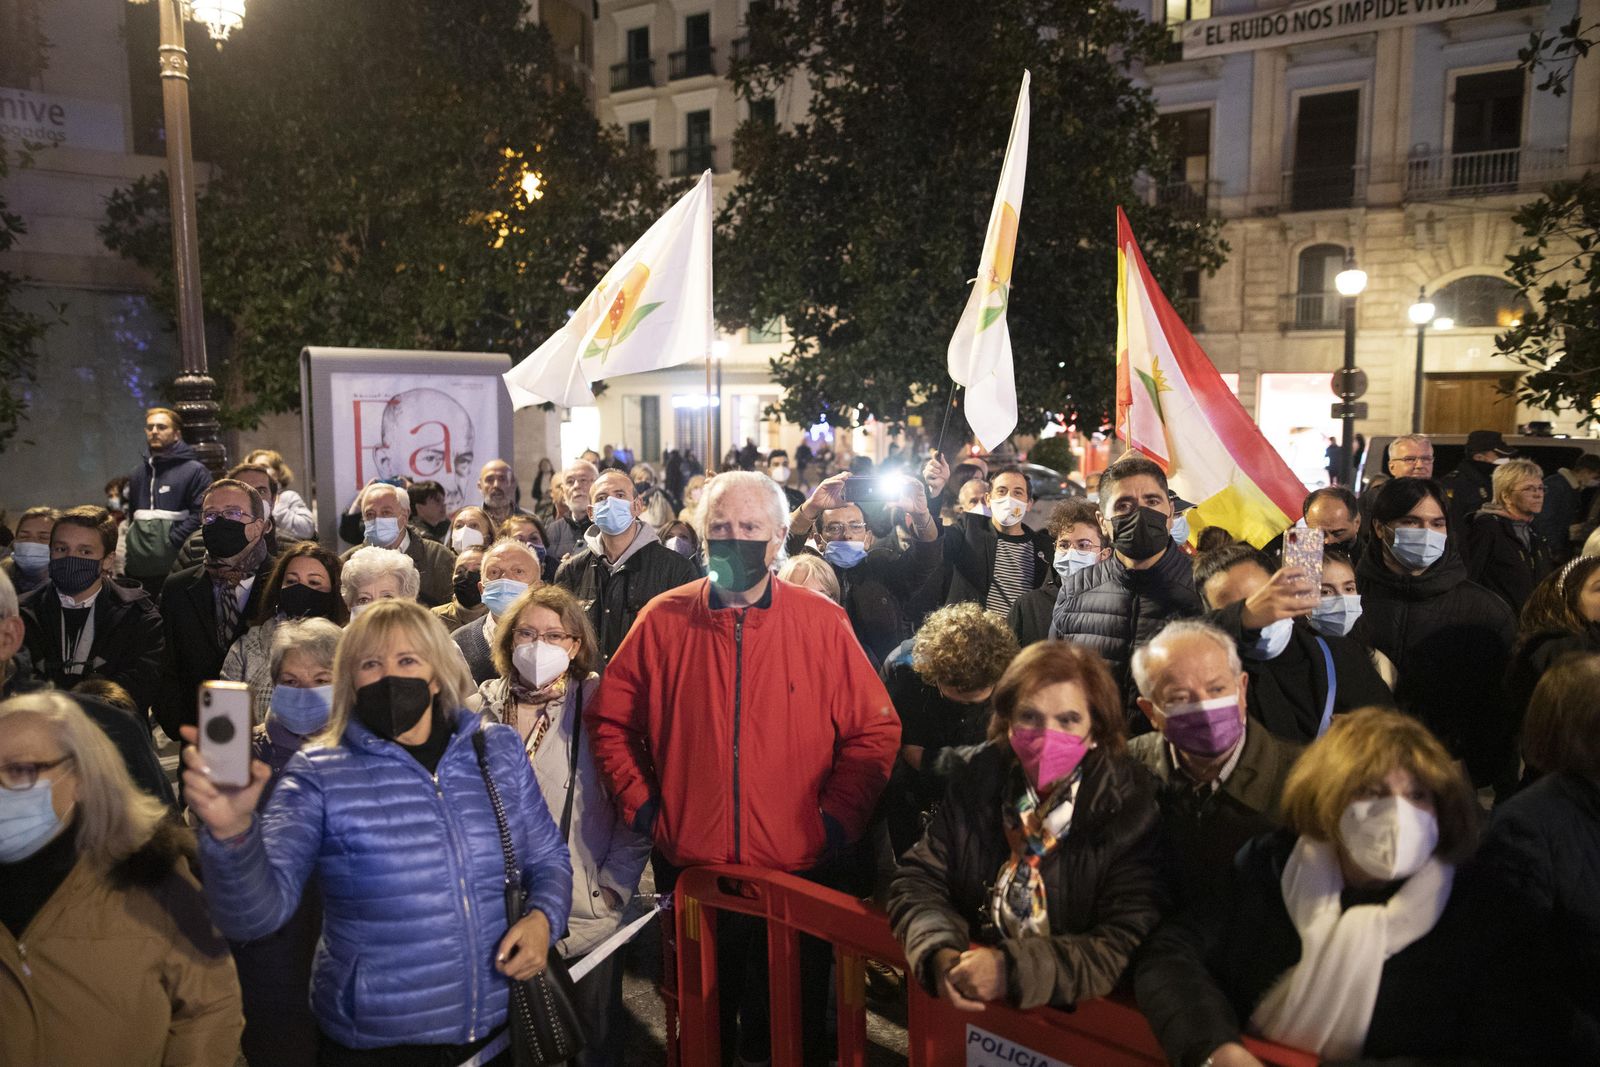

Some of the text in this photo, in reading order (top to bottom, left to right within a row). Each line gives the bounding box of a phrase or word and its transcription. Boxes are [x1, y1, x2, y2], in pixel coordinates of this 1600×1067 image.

[1206, 24, 1225, 46] EL
[1230, 14, 1288, 42] RUIDO
[1292, 4, 1333, 32] NOS
[1337, 0, 1408, 26] IMPIDE
